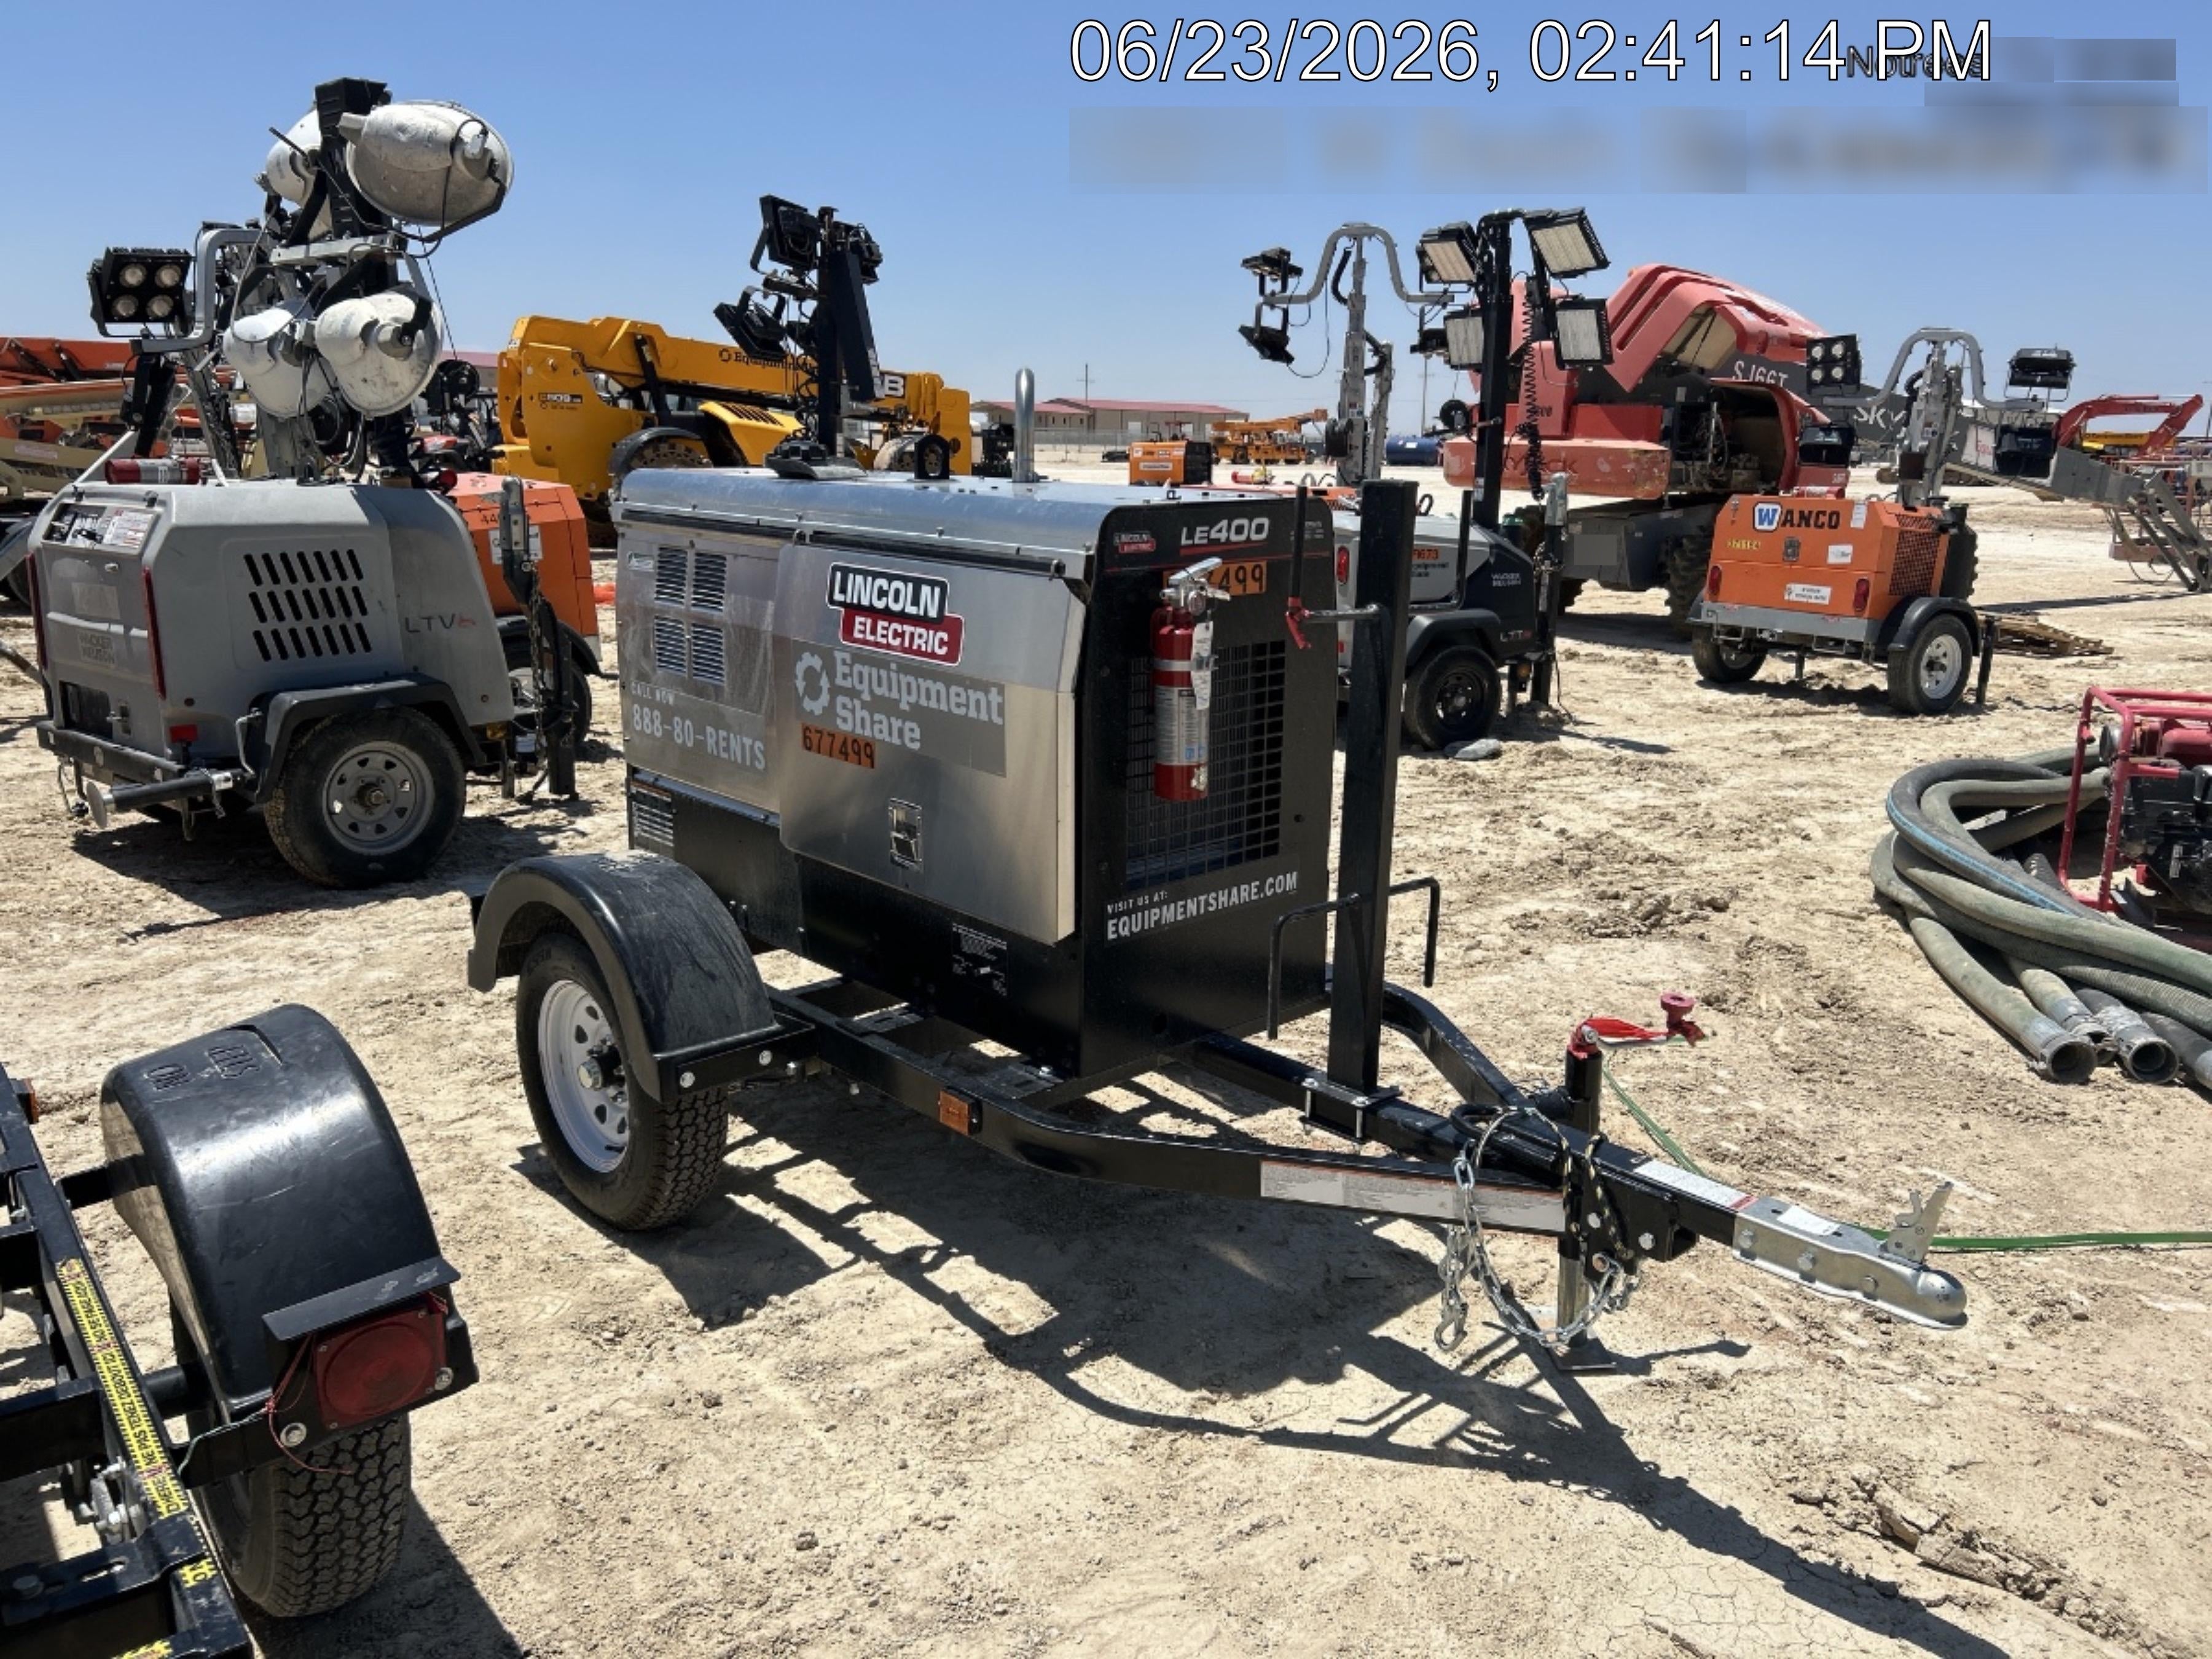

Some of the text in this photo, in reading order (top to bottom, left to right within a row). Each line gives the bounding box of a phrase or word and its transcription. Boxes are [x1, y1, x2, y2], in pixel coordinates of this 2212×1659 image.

[1181, 517, 1269, 546] LE400
[1757, 507, 1841, 530] WANCO
[833, 571, 943, 619] LINCOLN
[853, 615, 949, 656] ELECTRIC
[632, 681, 675, 707] CALL NOW
[834, 652, 1003, 725] Equipment
[633, 704, 766, 770] 888-80-RENTS
[836, 696, 921, 751] Share
[802, 727, 874, 766] 677499
[1107, 891, 1168, 914] VISIT US AT:
[1107, 871, 1298, 941] EQUIPMENTSHARE.COM
